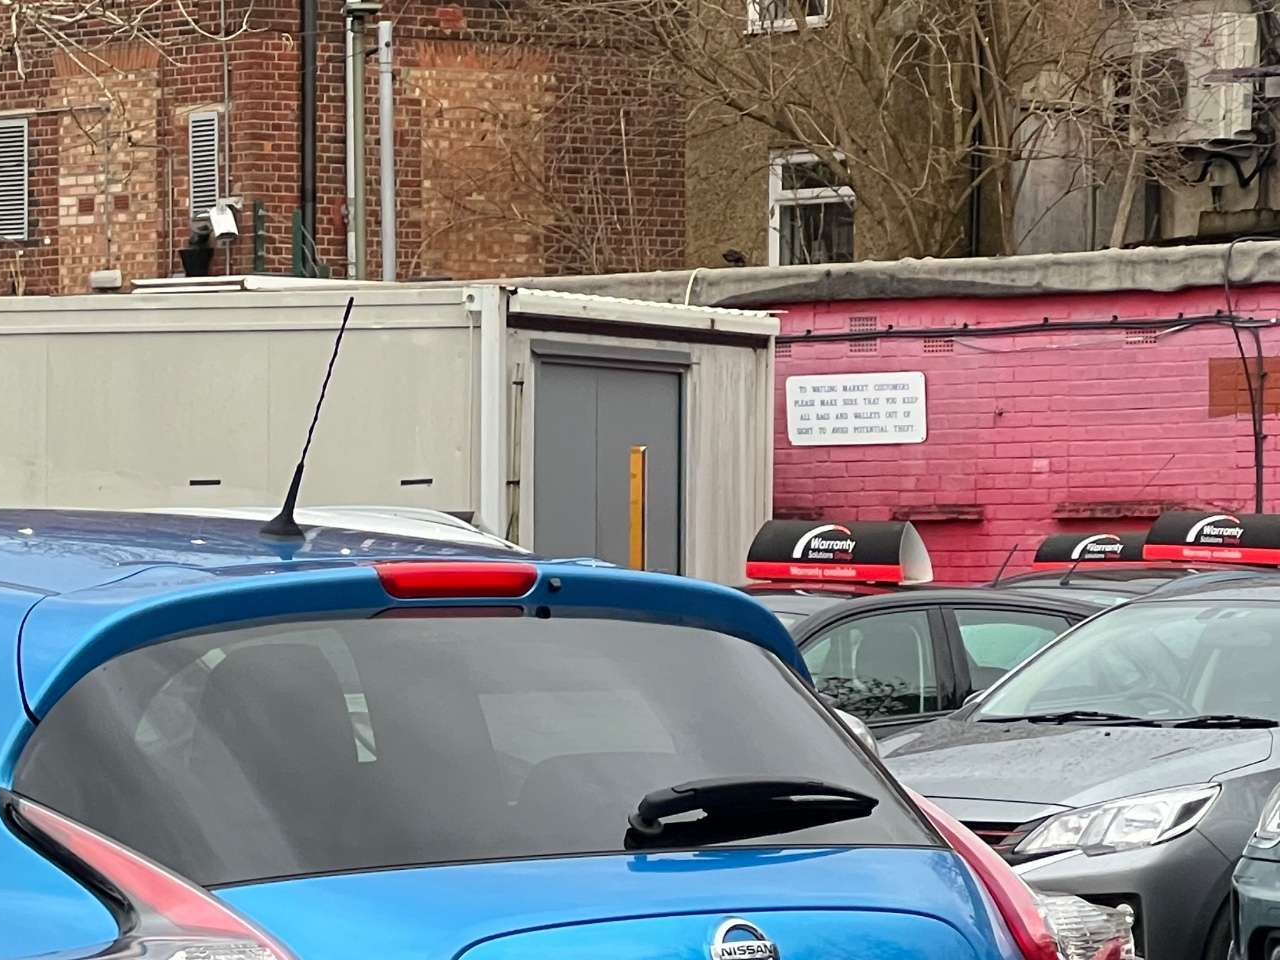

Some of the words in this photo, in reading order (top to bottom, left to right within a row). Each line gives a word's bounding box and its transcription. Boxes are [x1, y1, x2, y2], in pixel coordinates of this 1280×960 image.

[798, 386, 807, 394] TO
[793, 399, 816, 407] PLEASE
[820, 399, 838, 407] MAKE
[863, 397, 880, 405] THAT
[903, 396, 919, 404] KEEP
[800, 412, 811, 421] ALL
[835, 412, 849, 420] AND
[853, 411, 881, 419] WALLETS
[853, 425, 888, 433] POTENTIAL
[1203, 525, 1244, 539] Warranty
[811, 537, 856, 553] Warranty
[808, 550, 833, 559] Solutions
[721, 944, 773, 957] NISSAN
